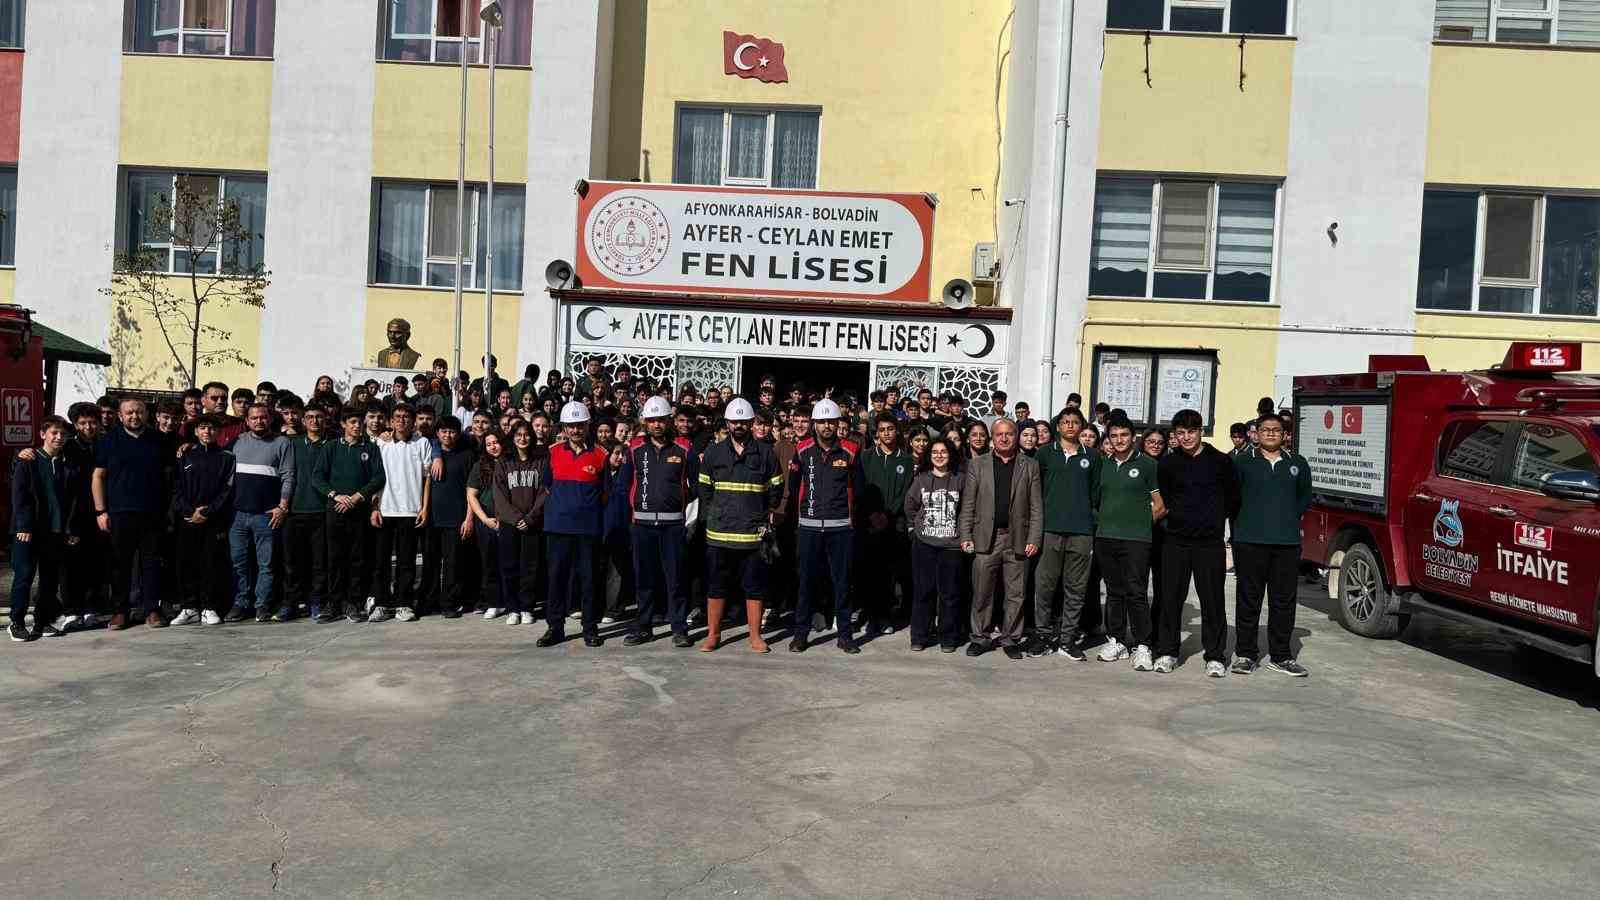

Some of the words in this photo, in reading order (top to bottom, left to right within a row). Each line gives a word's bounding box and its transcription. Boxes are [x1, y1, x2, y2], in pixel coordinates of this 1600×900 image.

[684, 202, 801, 219] AFYONKARAHİSAR
[813, 207, 879, 222] BOLVADİN
[683, 223, 742, 243] AYFER
[758, 227, 834, 247] CEYLAN
[840, 230, 893, 249] EMET
[681, 252, 755, 278] FEN
[768, 251, 888, 284] LİSESİ
[632, 312, 693, 342] AYFER
[699, 315, 774, 346] CEYLAN
[779, 319, 831, 348] EMET
[836, 322, 872, 350] FEN
[878, 324, 938, 353] LİSESİ
[1533, 347, 1562, 359] 112
[5, 396, 31, 421] 112
[1521, 525, 1545, 539] 112
[1497, 542, 1568, 585] İTFAİYE
[1509, 593, 1536, 612] HİZMETE
[1537, 603, 1578, 624] MAHSUSTUR
